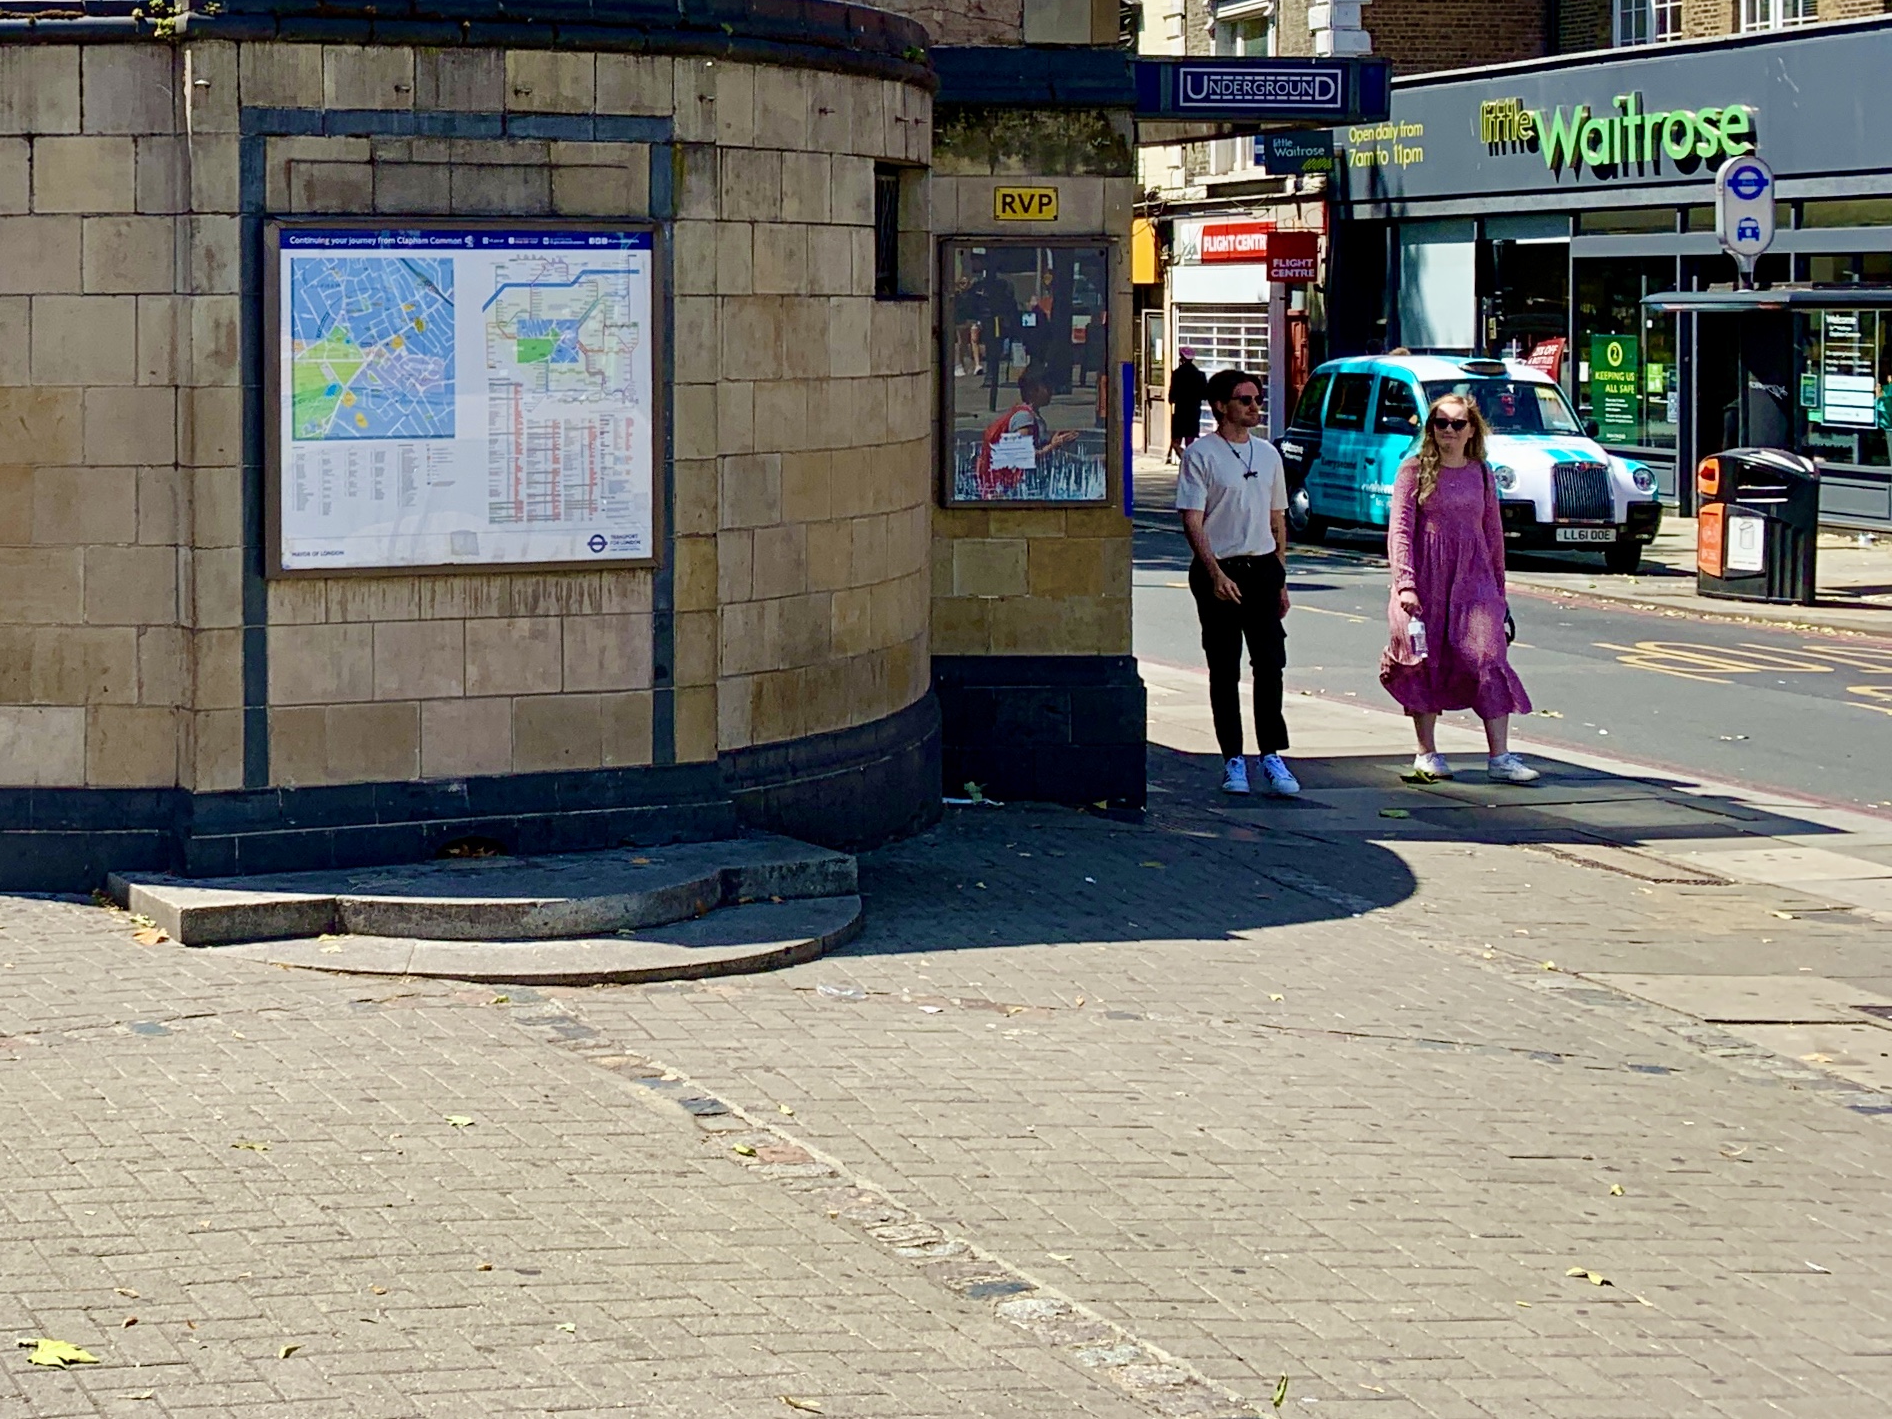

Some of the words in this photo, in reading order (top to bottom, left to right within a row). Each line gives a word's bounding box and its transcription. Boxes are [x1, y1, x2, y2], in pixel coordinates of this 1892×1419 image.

[1186, 74, 1336, 101] UNDERGROUND
[1349, 126, 1377, 143] Open
[1377, 123, 1399, 143] daily
[1399, 120, 1424, 137] from
[1480, 97, 1535, 143] little
[1533, 91, 1754, 170] Waitrose
[1273, 138, 1293, 148] little
[1274, 145, 1325, 157] Waitrose
[1349, 148, 1375, 168] 7am
[1377, 148, 1390, 166] to
[1393, 144, 1424, 171] 11pm
[1001, 193, 1053, 214] RVP
[289, 236, 330, 246] Continuing
[331, 238, 348, 246] your
[348, 237, 376, 246] journey
[377, 236, 396, 244] from
[396, 236, 429, 246] Clapham
[429, 236, 463, 244] Common
[1203, 234, 1235, 253] FLIGHT
[1235, 233, 1268, 251] CENTR
[1272, 258, 1314, 268] FLIGHT
[1271, 268, 1315, 278] CENTRE
[1610, 346, 1618, 359] 2
[1595, 371, 1625, 381] KEEPING
[1625, 371, 1635, 382] US
[1605, 384, 1618, 394] ALL
[1619, 384, 1635, 394] SAFE
